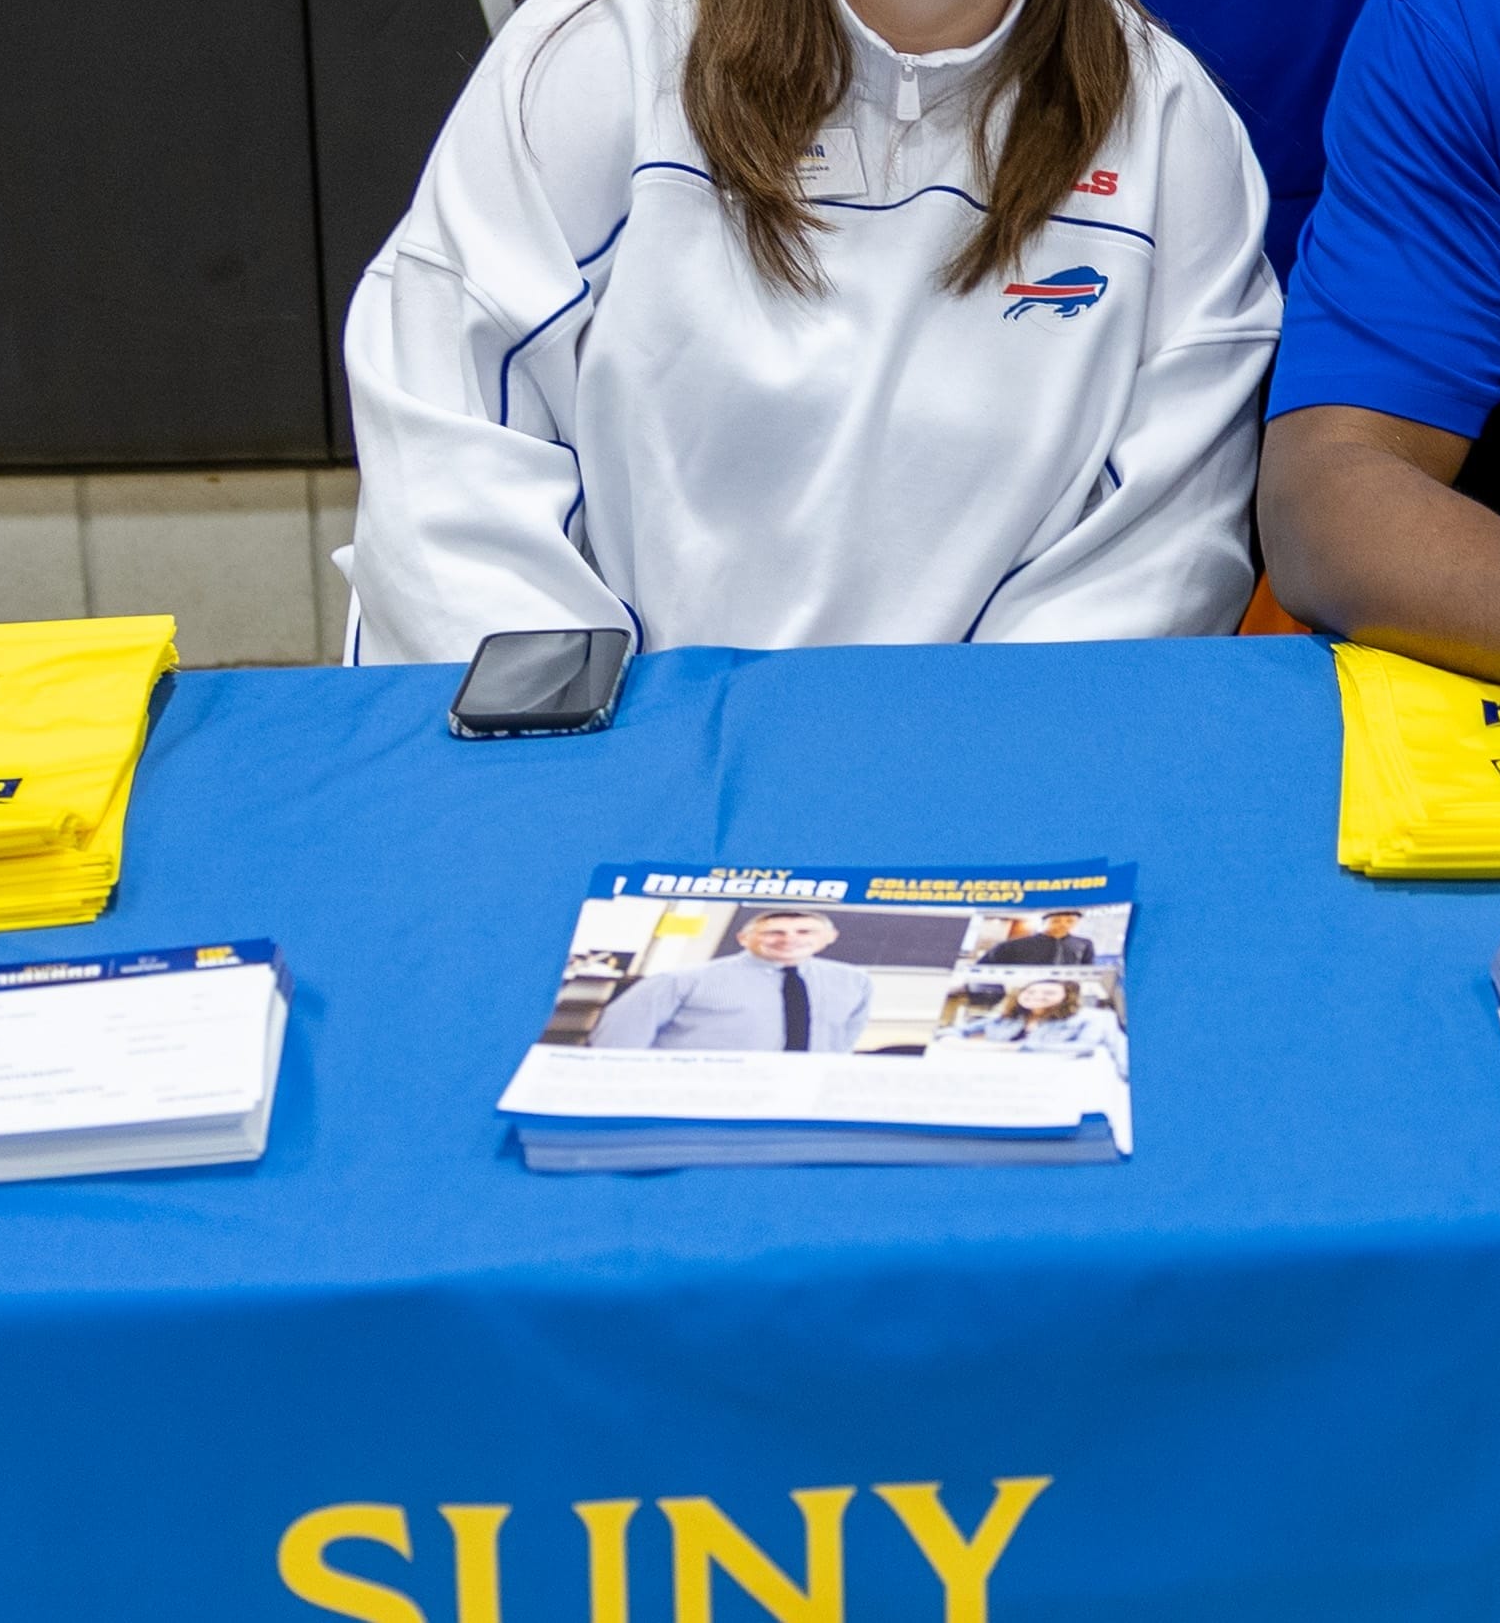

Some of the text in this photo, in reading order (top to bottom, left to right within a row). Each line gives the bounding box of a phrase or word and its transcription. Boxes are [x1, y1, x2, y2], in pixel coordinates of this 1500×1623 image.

[710, 867, 793, 880] SUNY
[643, 873, 849, 900] NIAGARA
[869, 878, 962, 891] COLLEGE
[866, 888, 1024, 904] PROGRAM (CAP)
